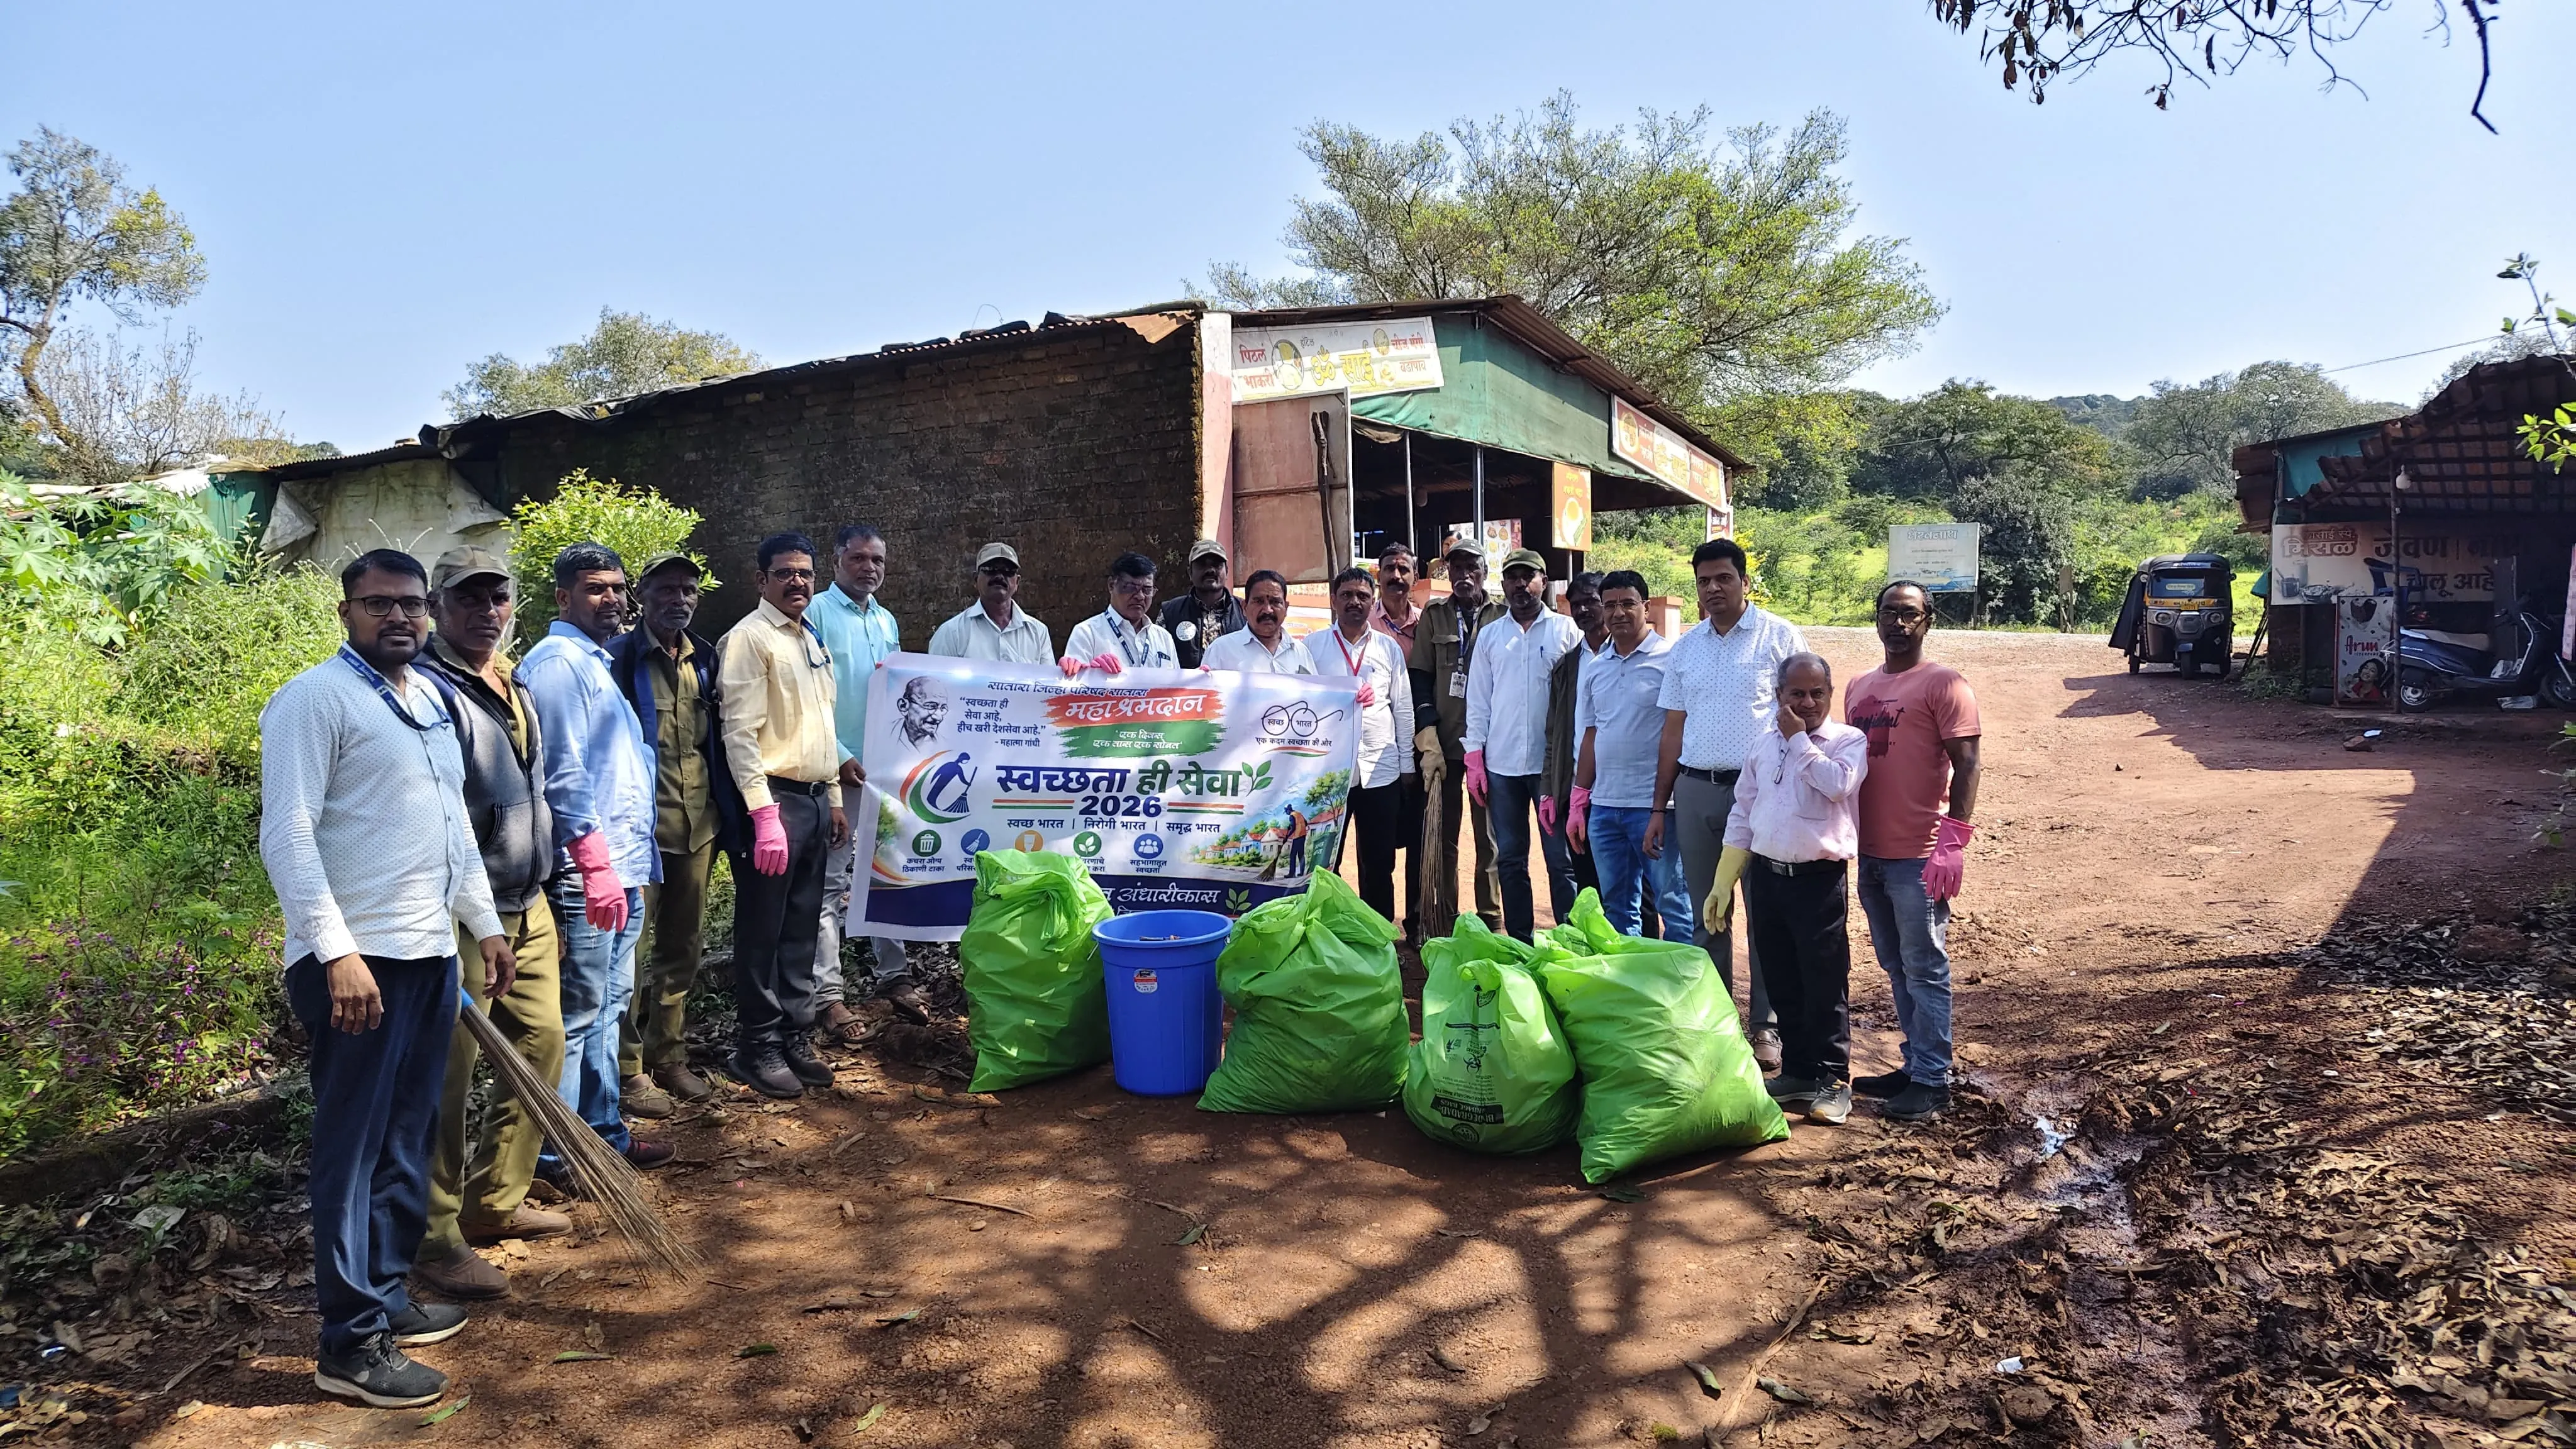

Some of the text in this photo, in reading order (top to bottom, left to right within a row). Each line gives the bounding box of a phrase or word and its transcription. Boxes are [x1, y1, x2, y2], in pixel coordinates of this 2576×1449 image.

[1240, 342, 1266, 364] पिठलं
[1339, 340, 1377, 387] साई
[1243, 368, 1275, 389] भाकरी
[2283, 538, 2356, 555] मिसळ
[2345, 635, 2379, 655] Arun
[987, 681, 1149, 697] सातारा जिल्हा परिषद सातारा
[997, 697, 1009, 709] ही
[965, 710, 1002, 722] सेवा आहे,
[957, 722, 972, 734] हीच
[974, 723, 991, 734] खरी
[992, 723, 1021, 735] देशसेवा
[1138, 729, 1165, 740] दिवस
[1000, 738, 1041, 747] महात्मा गांधी
[1312, 738, 1319, 747] की
[1321, 738, 1332, 747] ओर
[996, 759, 1243, 797] स्वच्छता ही सेवा
[1079, 795, 1162, 817] 2026
[1007, 817, 1221, 834] स्वच्छ भारत निरोगी भारत समृद्ध भारत
[902, 865, 926, 873] ठिकाणी
[1117, 882, 1221, 903] अंधारीकास
